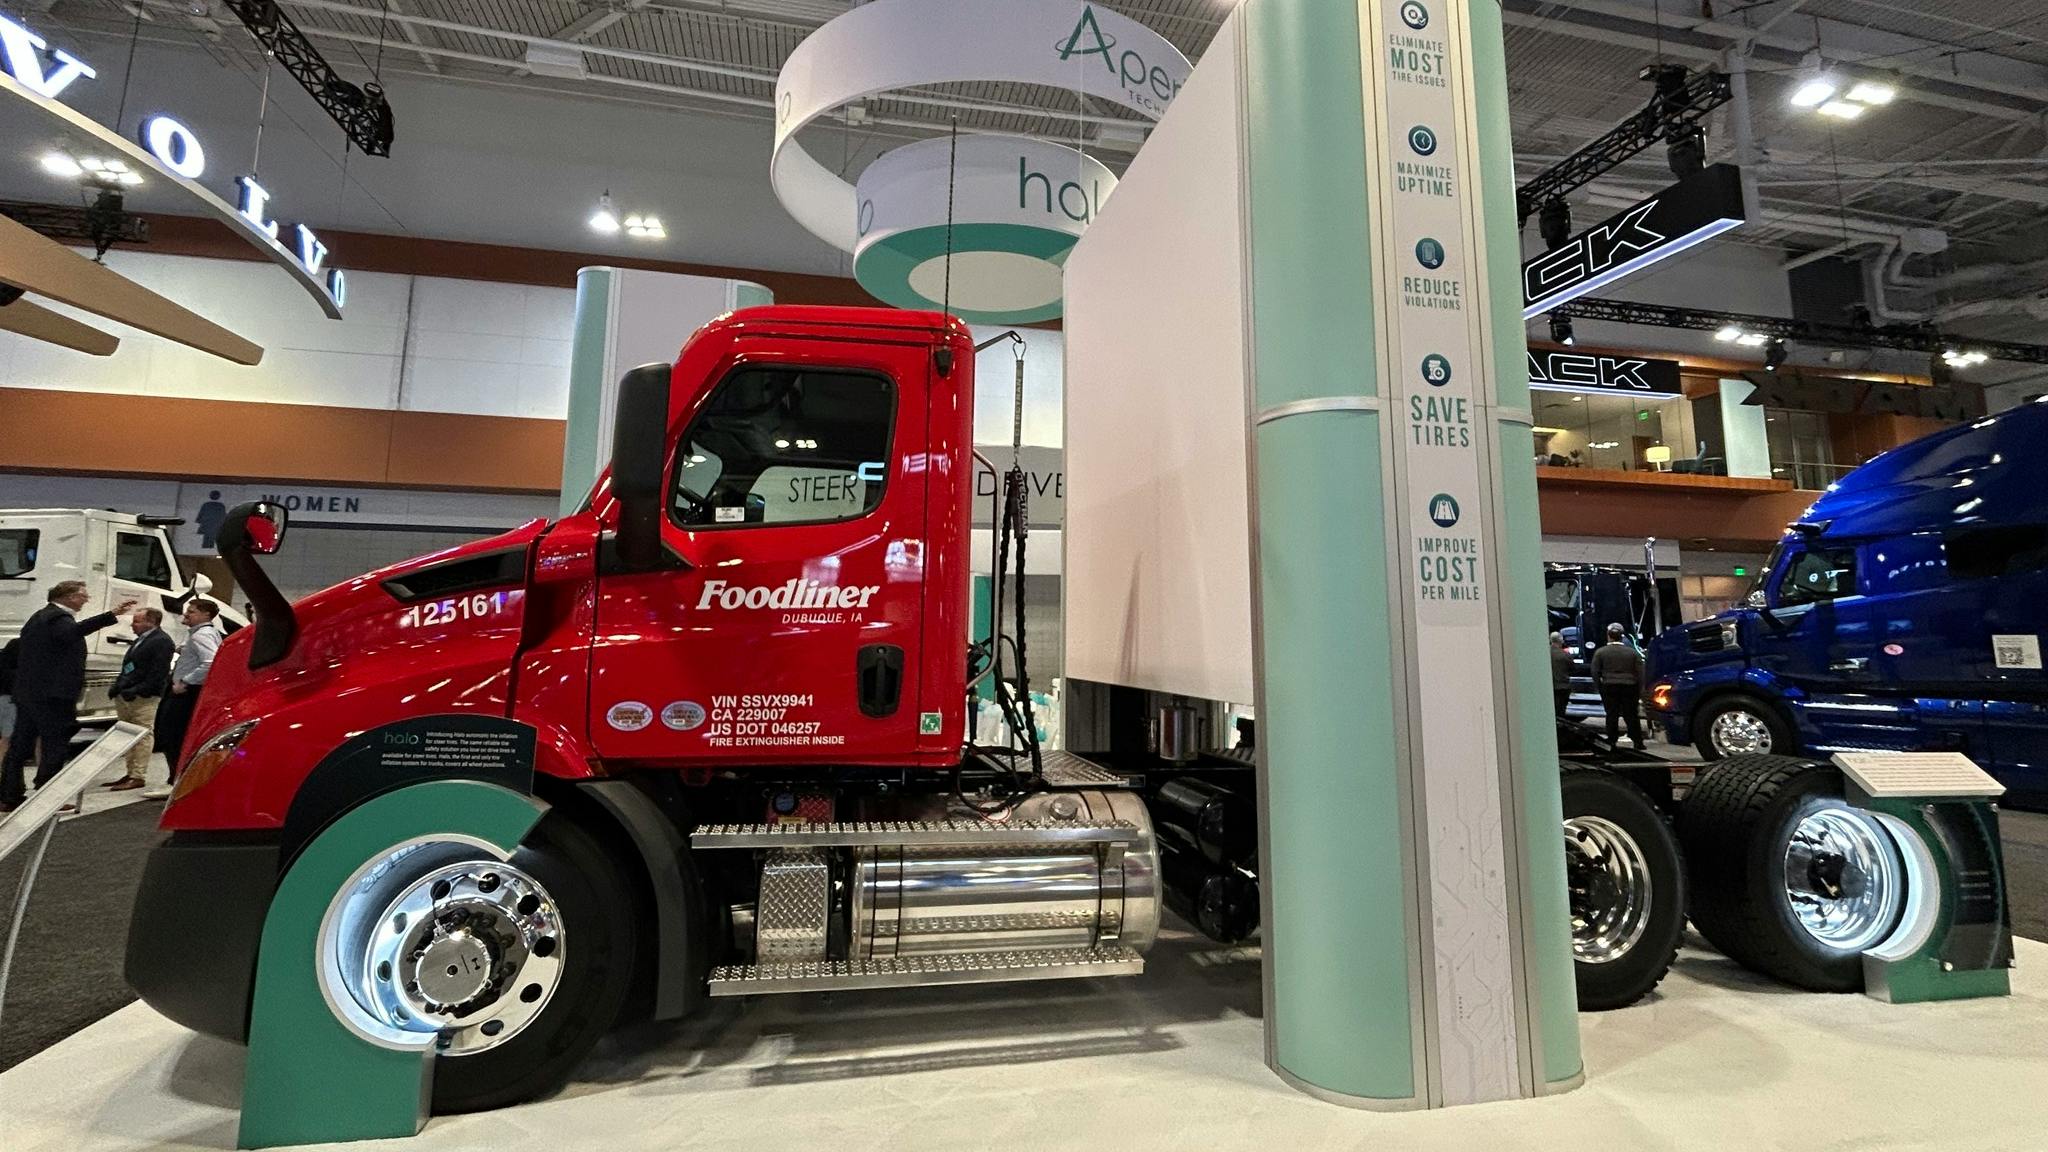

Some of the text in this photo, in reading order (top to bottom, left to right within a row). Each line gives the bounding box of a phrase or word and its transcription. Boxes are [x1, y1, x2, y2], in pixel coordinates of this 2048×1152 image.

[1058, 5, 1187, 100] Aper
[1390, 34, 1443, 53] ELIMINATE
[1391, 48, 1444, 76] MOST
[1392, 71, 1446, 88] TIRE ISSUES
[1129, 90, 1165, 114] TECH
[0, 14, 345, 308] VOLVO
[1397, 162, 1452, 180] MAXIMIZE
[1398, 176, 1453, 197] UPTIME
[1404, 276, 1460, 297] REDUCE
[1405, 295, 1461, 310] VIOLATIONS
[1411, 395, 1468, 424] SAVE
[1412, 424, 1470, 447] TIRES
[788, 474, 858, 503] STEER
[1419, 537, 1476, 554] IMPROVE
[1420, 556, 1477, 583] COST
[695, 578, 880, 610] Foodliner
[1422, 585, 1480, 600] PER MILE
[409, 591, 502, 628] 125161
[782, 613, 863, 624] DUBUQUE, IA
[712, 694, 814, 708] VIN SSVX9941
[712, 709, 733, 721] CA
[737, 708, 787, 721] 229007
[384, 732, 419, 745] halo
[710, 722, 821, 735] US DOT 046257
[709, 735, 845, 747] FIRE EXTINGUISHER INSIDE
